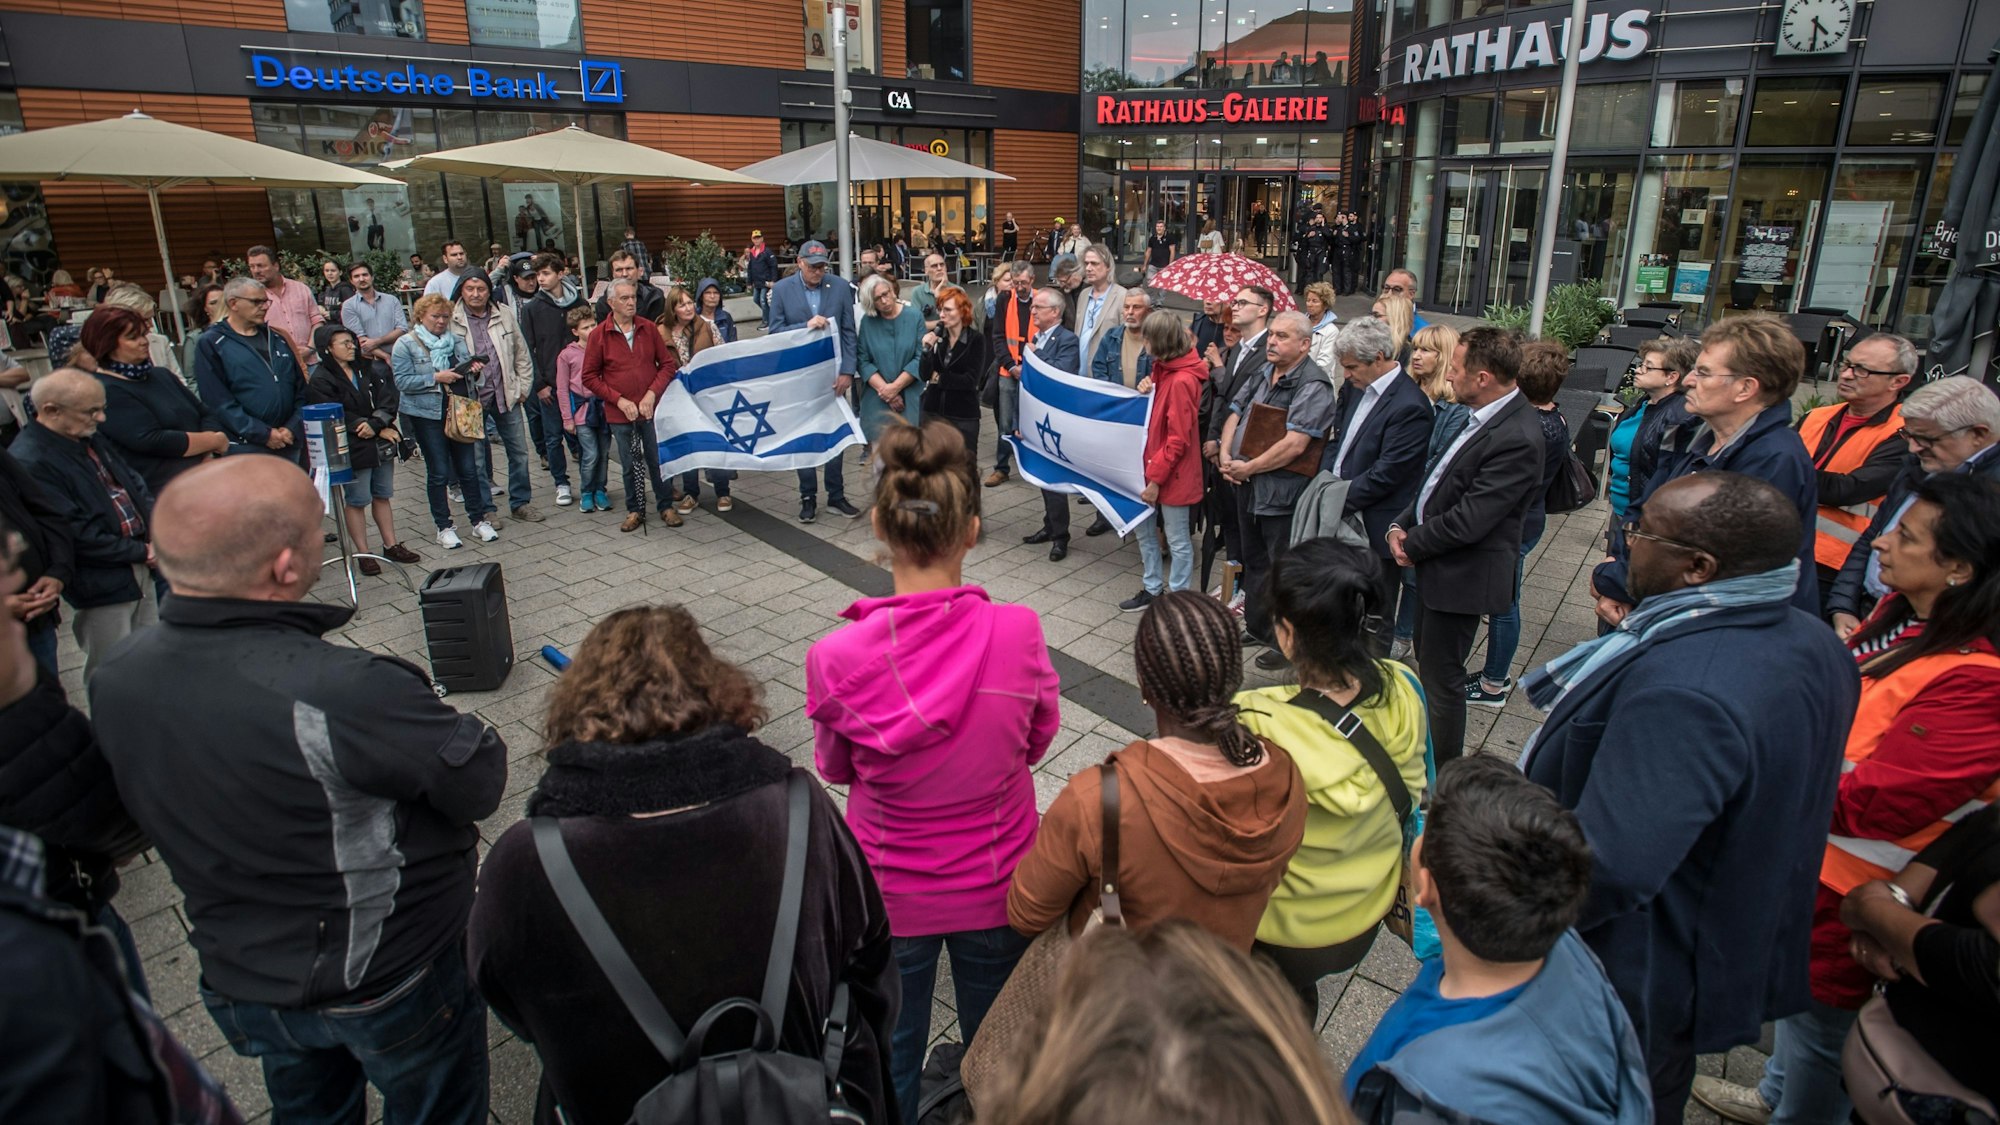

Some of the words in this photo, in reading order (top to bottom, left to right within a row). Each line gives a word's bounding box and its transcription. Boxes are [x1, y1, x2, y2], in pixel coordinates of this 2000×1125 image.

[1403, 9, 1652, 85] RATHAUS
[251, 54, 454, 97] Deutsche
[467, 67, 561, 100] Bank
[887, 90, 913, 110] C&A
